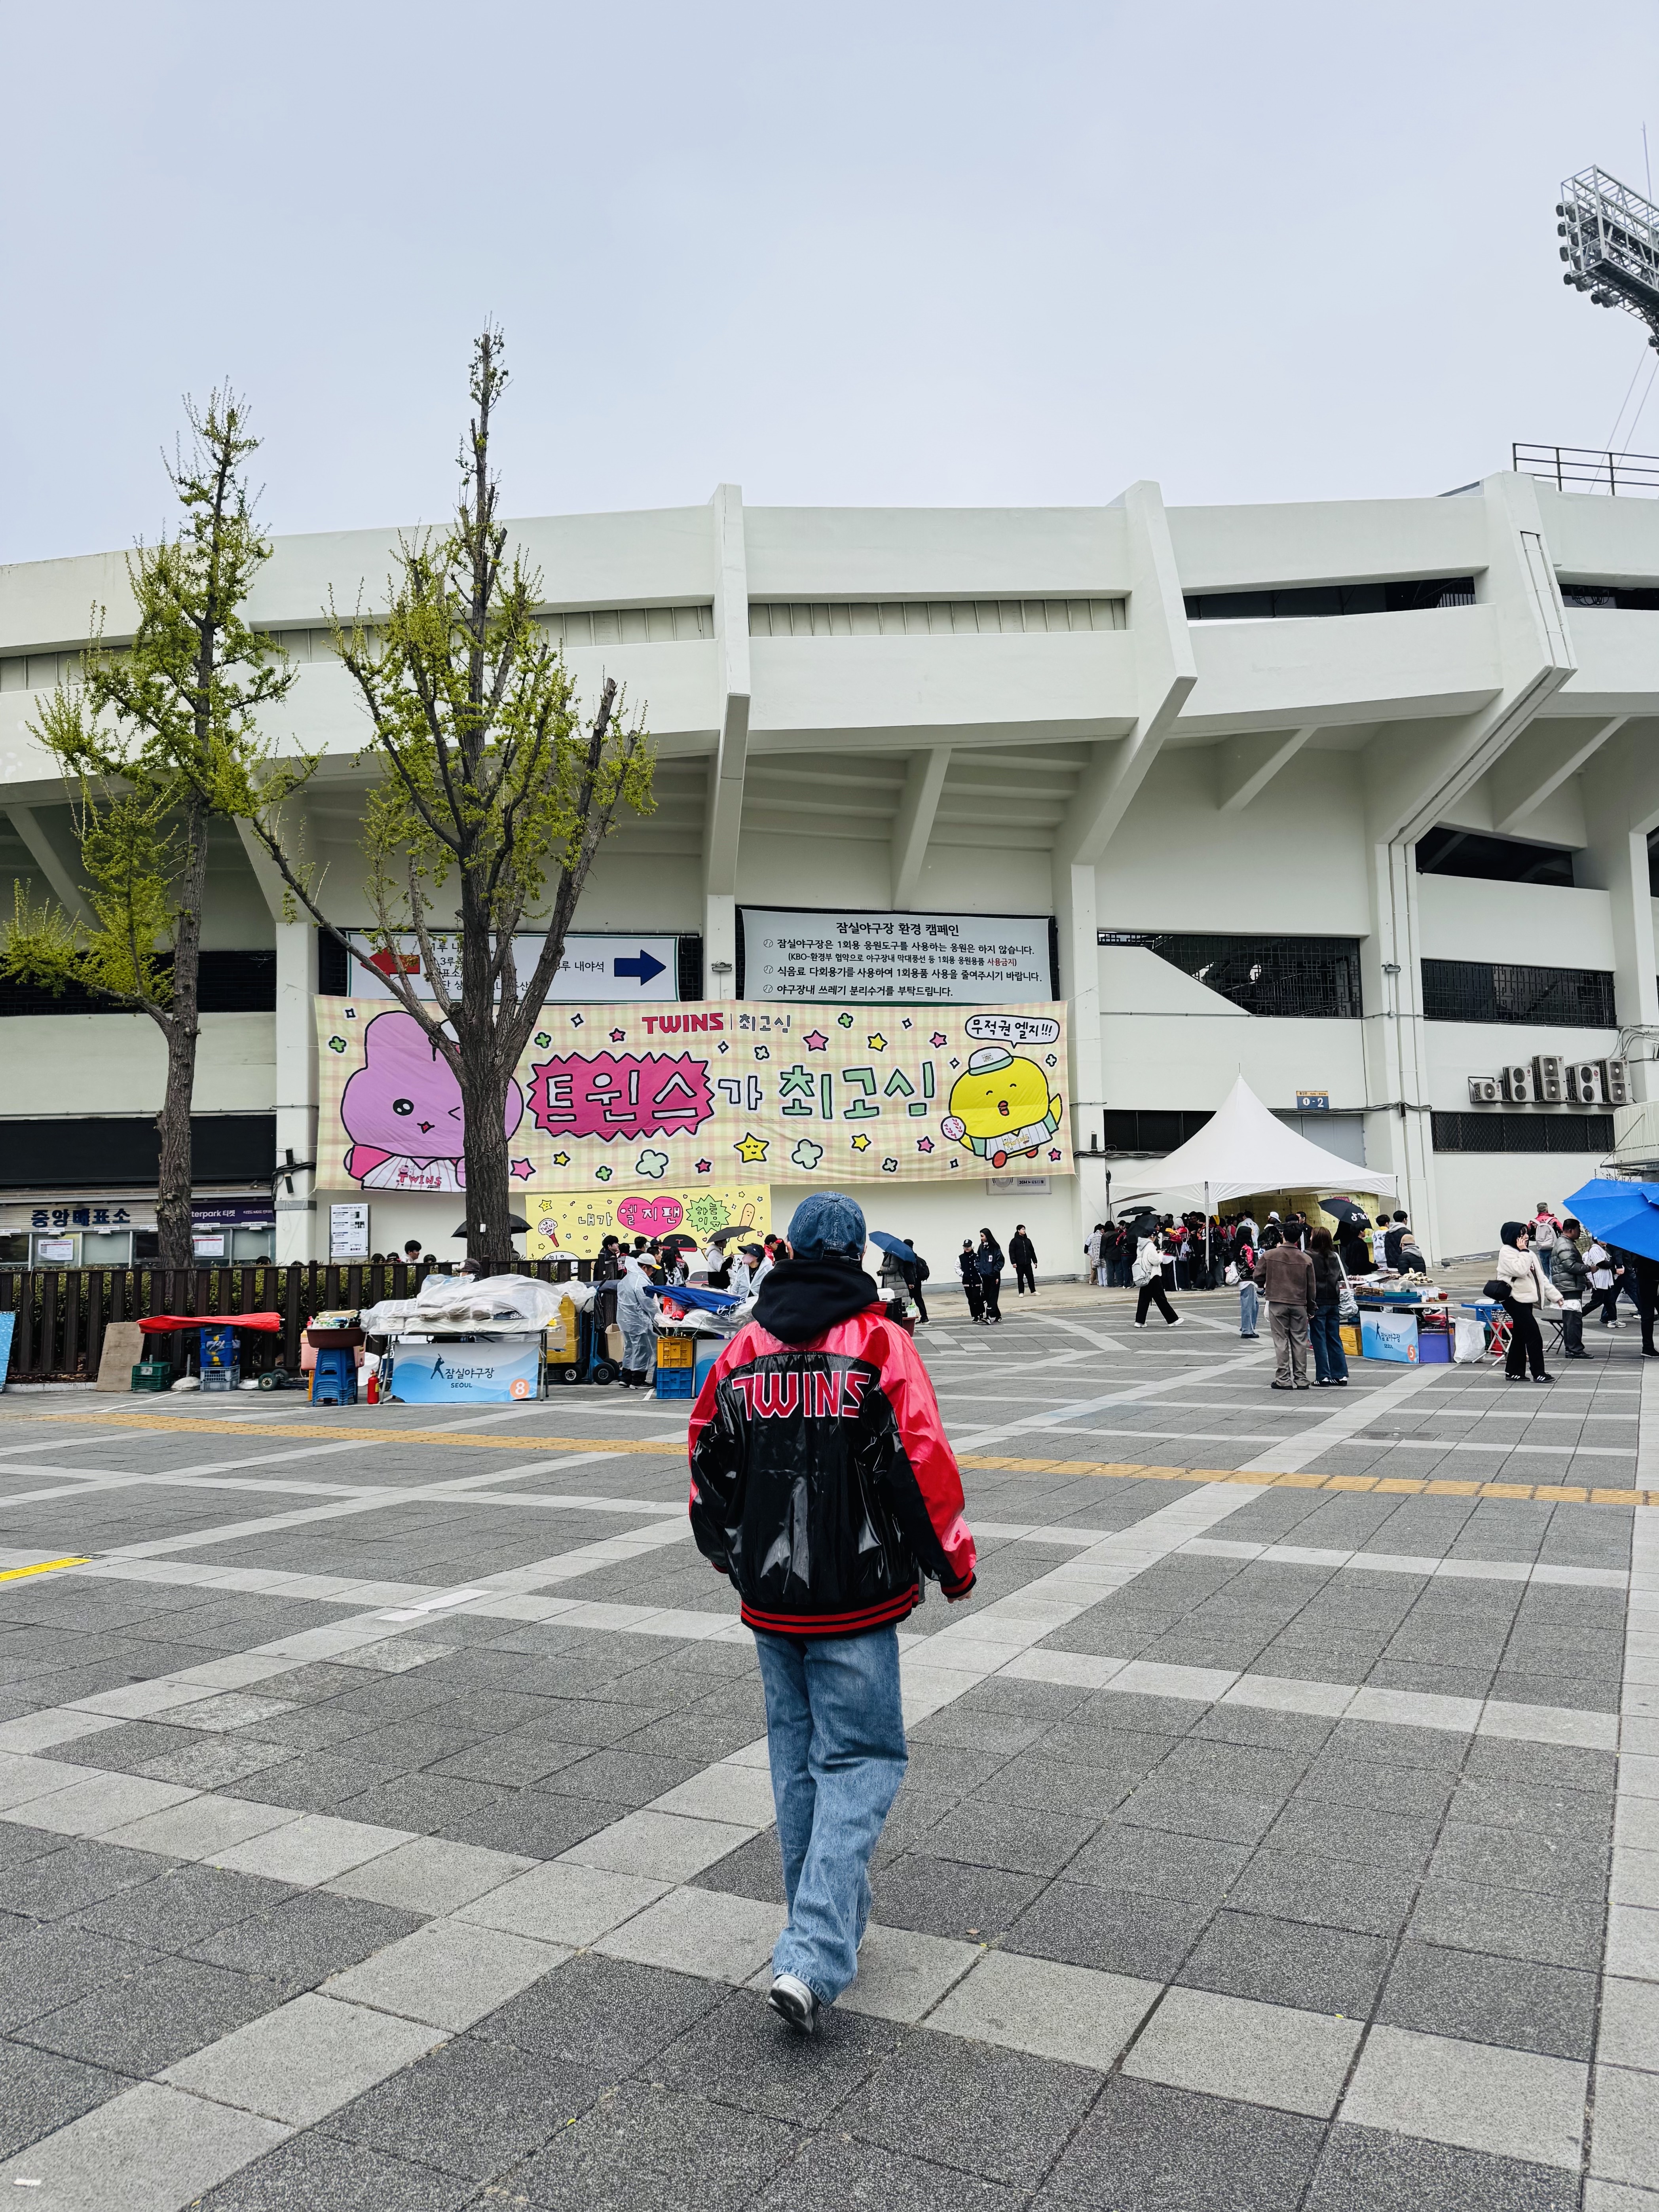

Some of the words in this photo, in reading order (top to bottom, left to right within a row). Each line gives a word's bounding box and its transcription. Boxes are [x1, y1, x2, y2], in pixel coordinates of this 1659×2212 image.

[836, 922, 894, 934] 잠실야구장
[898, 923, 921, 935] 환경
[925, 924, 959, 937] 캠페인
[777, 939, 834, 949] 잠실야구장은
[837, 941, 861, 950] 1회용
[864, 941, 909, 951] 응원도구를
[911, 942, 947, 952] 사용하는
[950, 943, 975, 953] 응원은
[978, 945, 995, 954] 하지
[998, 945, 1035, 955] 않습니다.
[575, 961, 604, 973] 내야석
[788, 952, 833, 962] (KBO-환경부
[835, 953, 864, 962] 협약으로
[866, 954, 895, 963] 야구장내
[897, 954, 926, 964] 막대풍선
[928, 955, 936, 964] 등
[938, 956, 955, 965] 1회용
[958, 956, 985, 966] 응원용품
[987, 958, 1017, 967] 사용금지)
[777, 966, 806, 977] 식음료
[809, 967, 856, 977] 다회용기를
[857, 968, 893, 978] 사용하여
[897, 968, 928, 979] 1회용품
[931, 969, 958, 979] 사용을
[961, 970, 1003, 981] 줄여주시기
[1006, 971, 1042, 982] 바랍니다.
[776, 984, 815, 995] 야구장내
[818, 985, 846, 996] 쓰레기
[849, 985, 895, 996] 분리수거를
[897, 986, 953, 997] 부탁드립니다.
[642, 1012, 723, 1034] TWINS
[739, 1014, 791, 1033] 최고심
[971, 1019, 1011, 1036] 무적권
[779, 1061, 934, 1120] 최고심
[398, 1173, 442, 1186] TWINS
[578, 1212, 613, 1226] 내가
[620, 1204, 680, 1226] 엘지팬
[1381, 1332, 1400, 1343] 잠실야구장
[1410, 1347, 1414, 1358] 5
[445, 1367, 495, 1379] 잠실야구장
[515, 1381, 525, 1395] 8
[732, 1370, 871, 1421] TWINS
